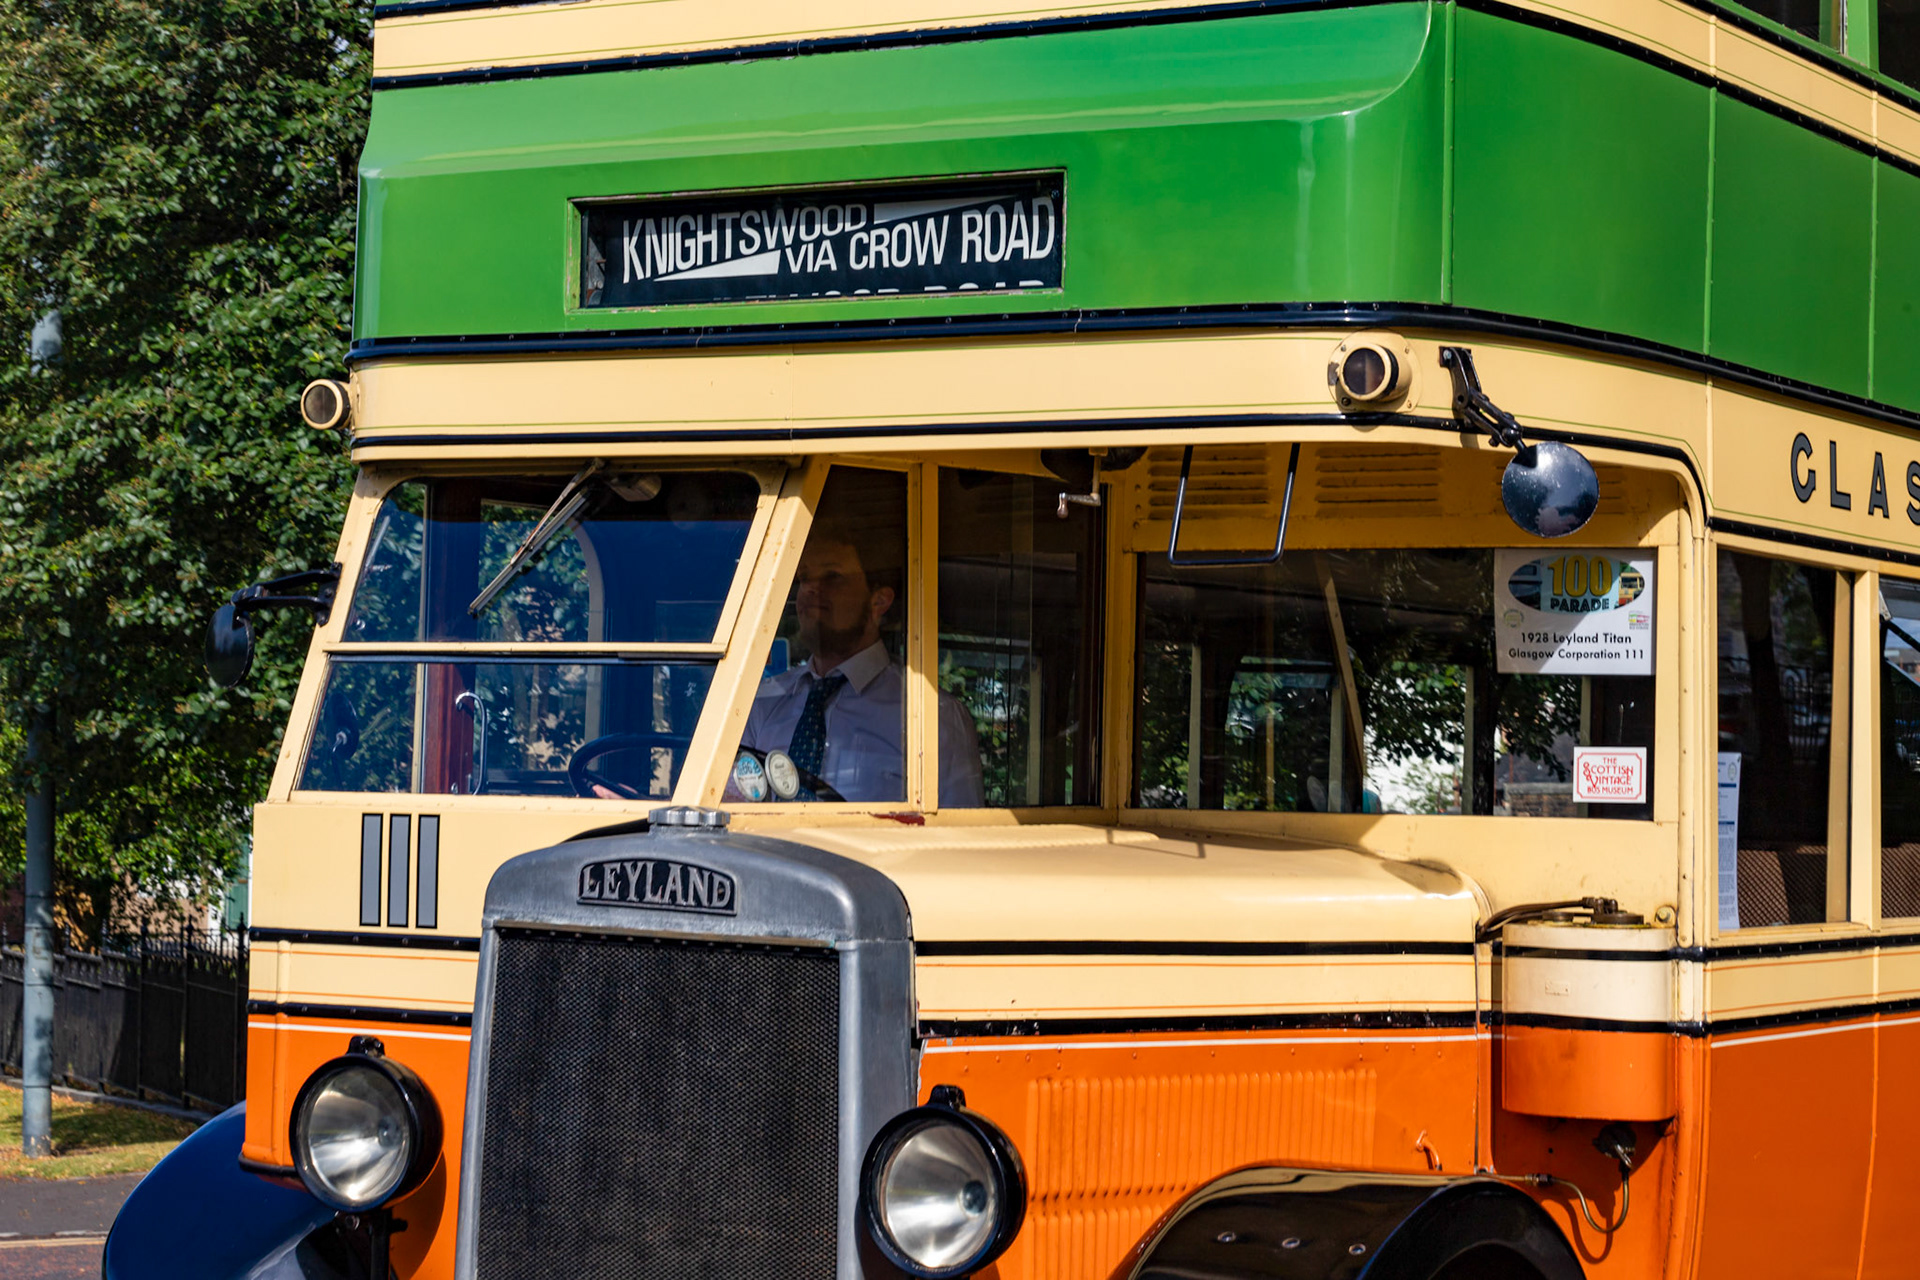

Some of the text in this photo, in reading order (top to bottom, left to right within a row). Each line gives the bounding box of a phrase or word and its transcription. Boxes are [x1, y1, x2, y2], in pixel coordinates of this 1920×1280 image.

[785, 196, 1056, 273] VIA CROW ROAD
[623, 204, 867, 284] KNIGHTSWOOD
[1790, 431, 1920, 526] GLAS
[1547, 555, 1613, 597] 100
[1550, 598, 1610, 613] PARADE
[1521, 632, 1632, 647] 1928 Leyland Titan
[1508, 647, 1644, 662] Glasgow Corporation 111
[1603, 757, 1617, 765] THE
[1583, 762, 1633, 777] SCOTTISH
[1588, 775, 1632, 787] VINTAGE
[1587, 786, 1633, 795] BUS MUSEUM
[359, 812, 441, 929] 111
[581, 860, 732, 908] LEYLAND
